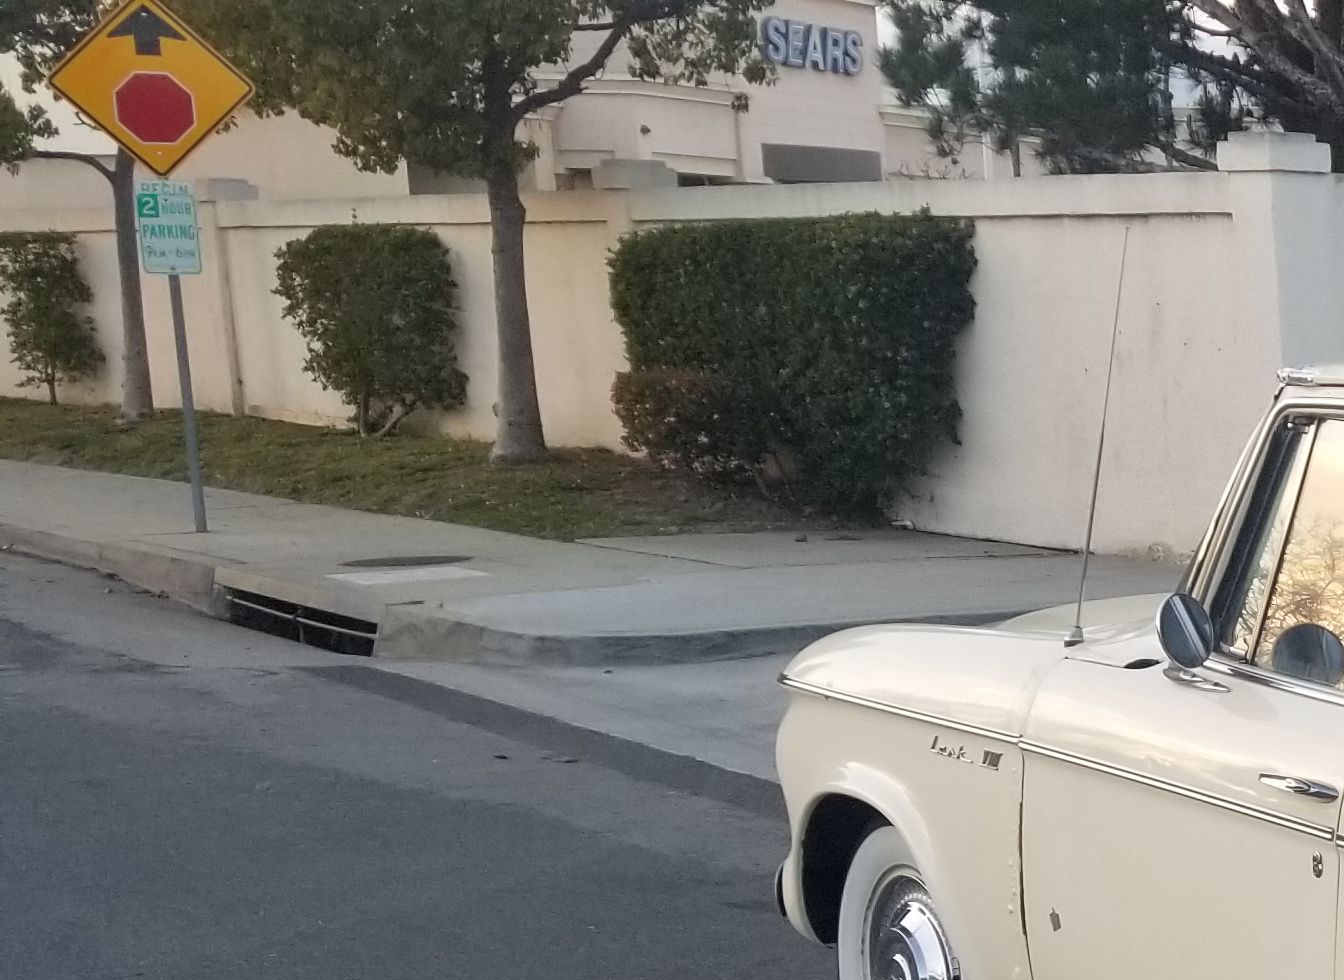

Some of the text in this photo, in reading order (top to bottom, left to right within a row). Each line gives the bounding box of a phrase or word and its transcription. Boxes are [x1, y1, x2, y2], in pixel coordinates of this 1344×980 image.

[762, 16, 863, 76] SEARS
[142, 198, 192, 215] 2 HOUR
[142, 224, 195, 240] PARKING
